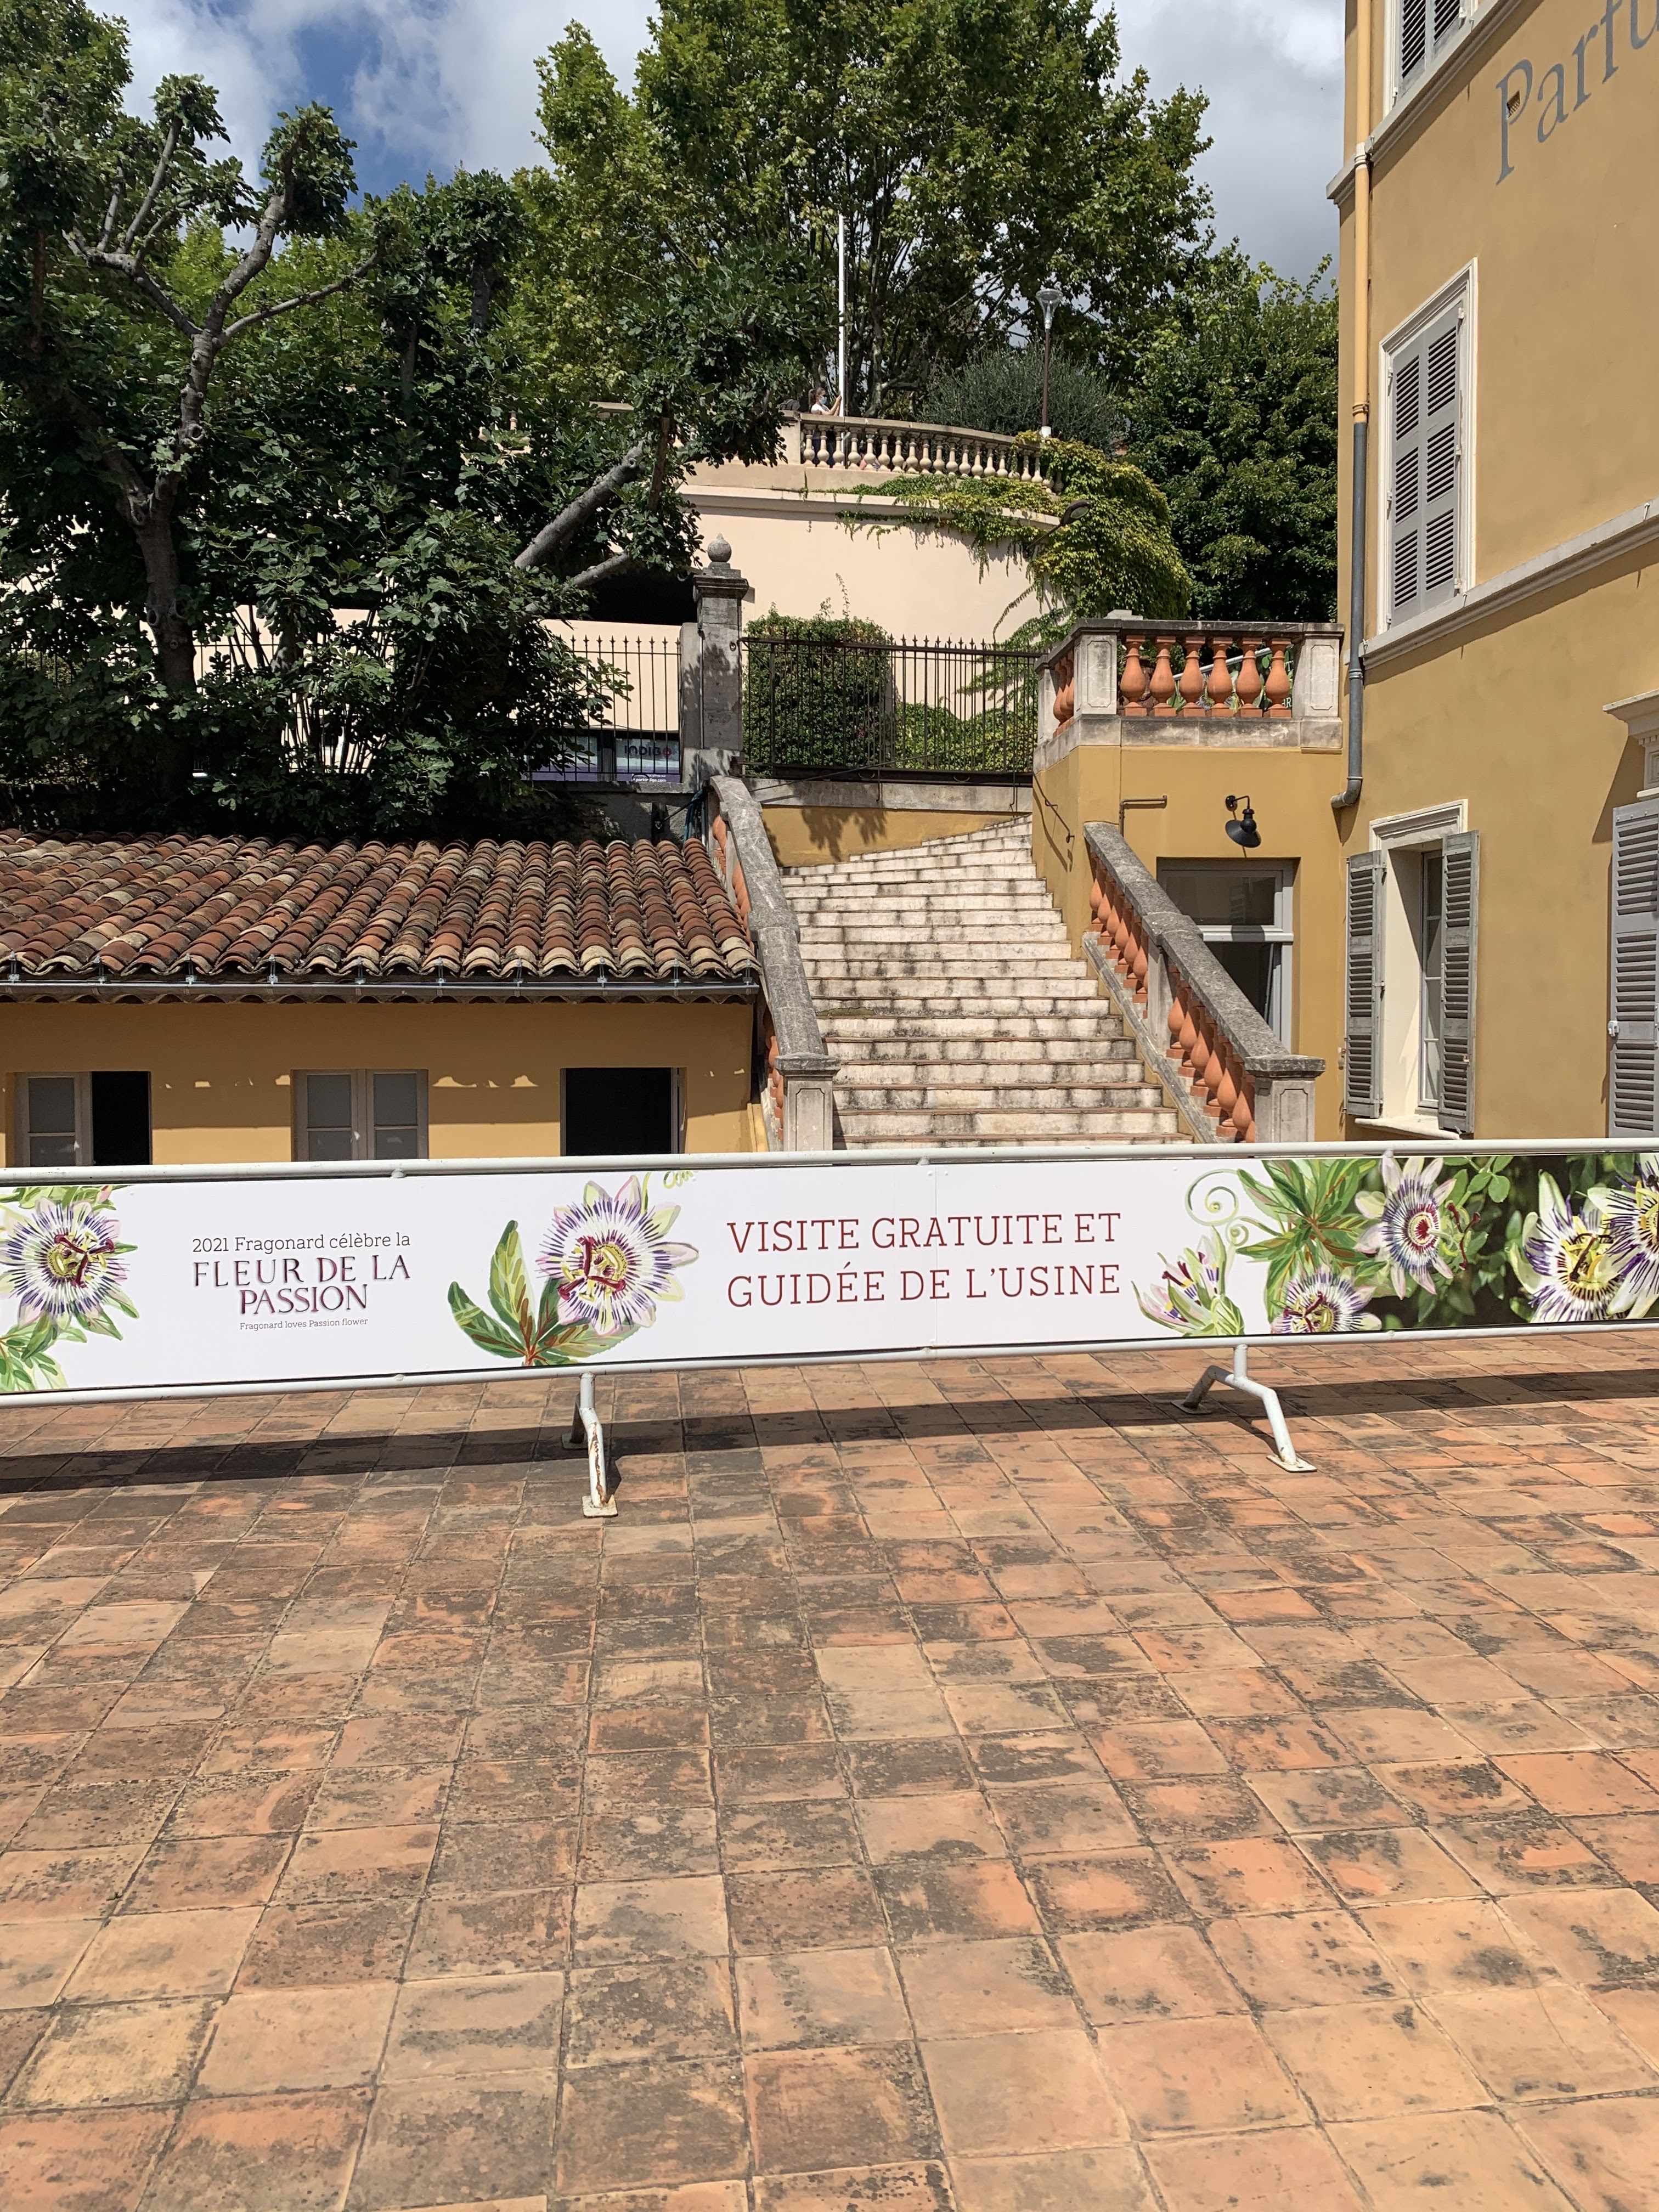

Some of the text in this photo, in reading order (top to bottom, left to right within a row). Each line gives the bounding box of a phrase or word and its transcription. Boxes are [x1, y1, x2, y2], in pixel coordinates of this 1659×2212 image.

[192, 1232, 411, 1255] 2021 Fragonard célèbre la
[726, 1212, 1121, 1253] VISITE GRATUITE ET
[193, 1254, 411, 1287] FLEUR DE LA
[727, 1261, 1120, 1307] GUIDÉE DE L'USINE
[239, 1284, 368, 1314] PASSION
[239, 1321, 283, 1331] Fragonard
[308, 1319, 340, 1328] Passion
[341, 1318, 369, 1327] flower
